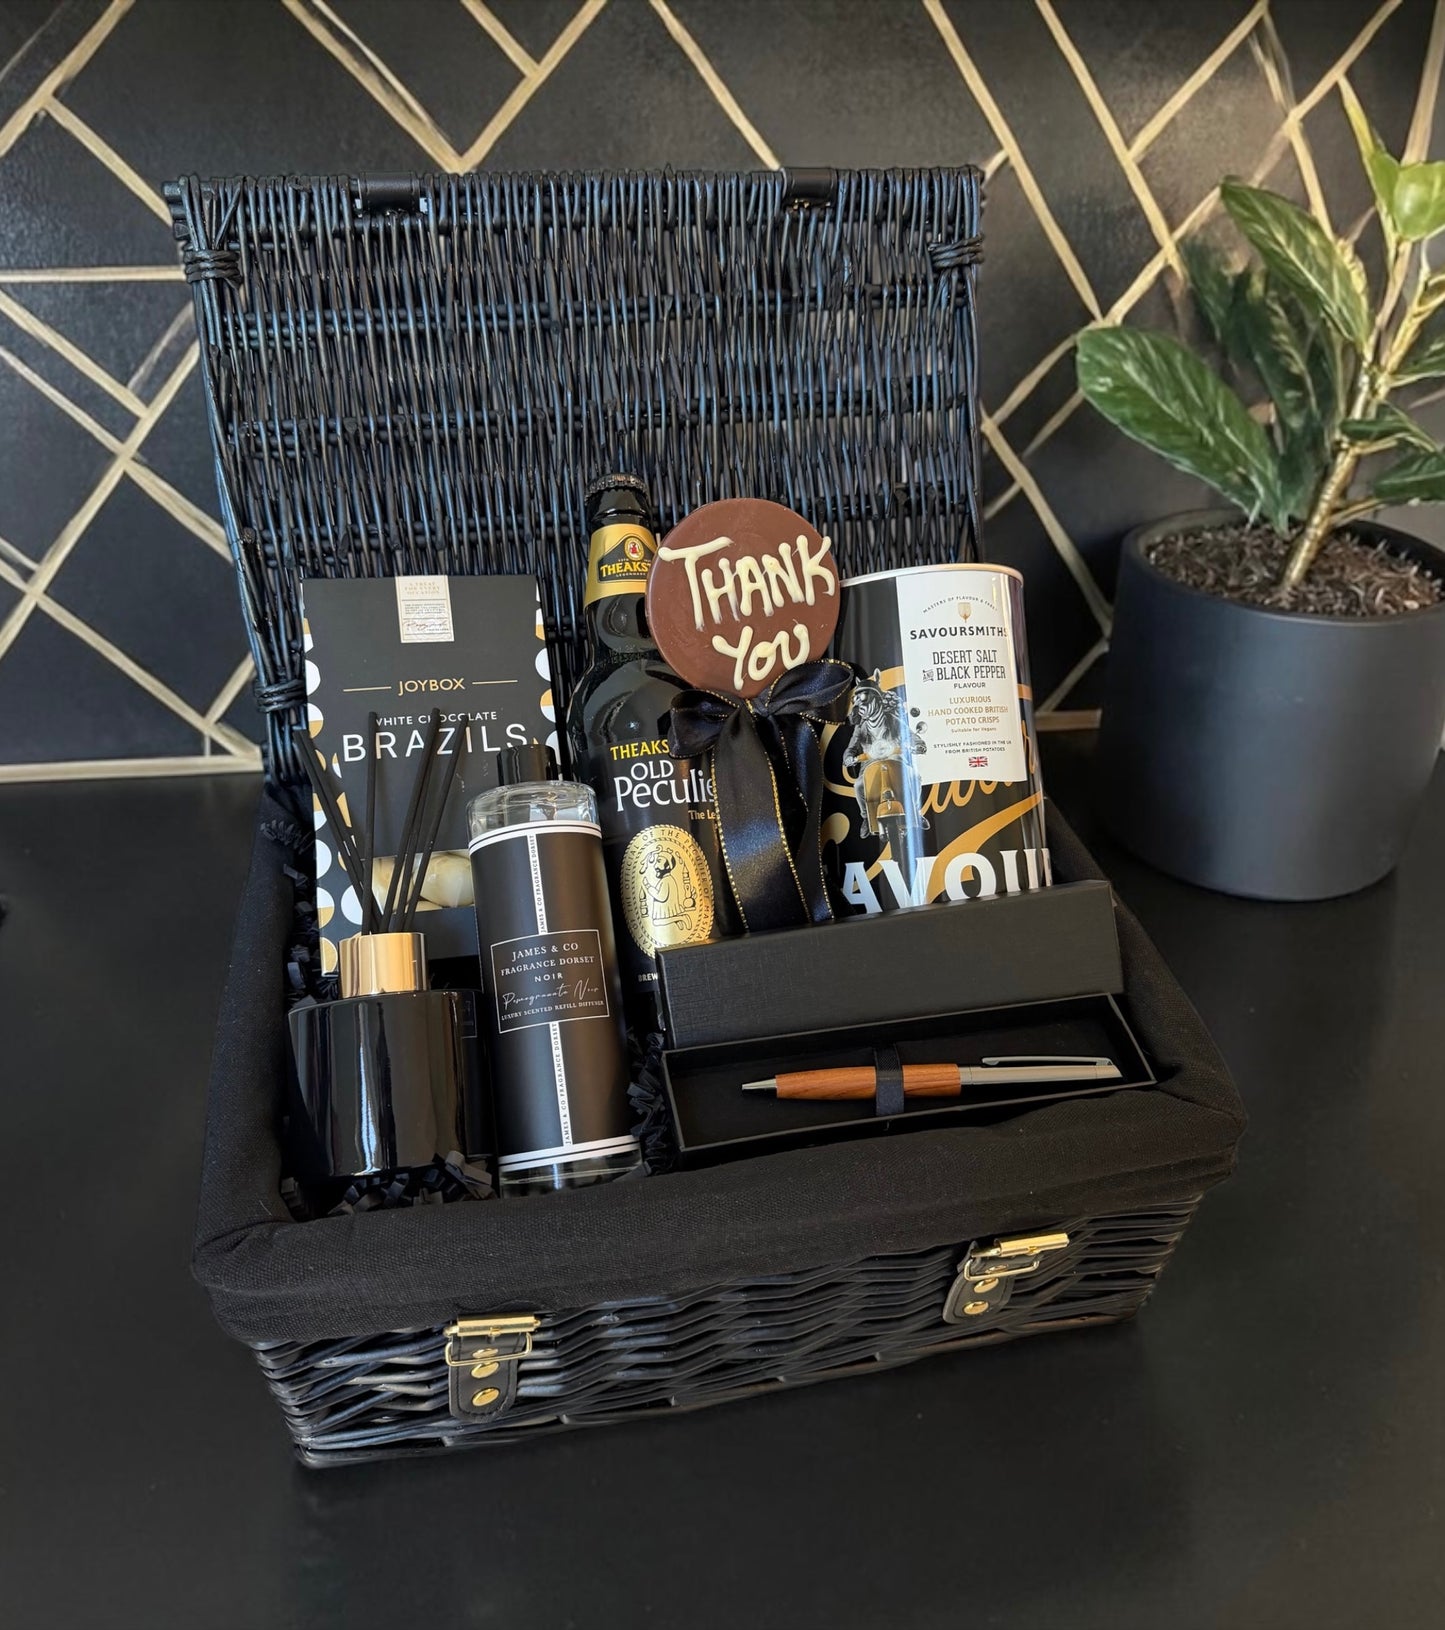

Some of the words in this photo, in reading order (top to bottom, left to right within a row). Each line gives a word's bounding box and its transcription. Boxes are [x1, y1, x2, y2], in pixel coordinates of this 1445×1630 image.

[658, 534, 835, 631] THANK
[923, 600, 946, 613] MASTERS
[932, 650, 972, 665] DESERT
[976, 649, 997, 663] SALT
[936, 665, 971, 681] BLACK
[974, 665, 1006, 679] PEPPER
[398, 677, 466, 696] JOYBOX
[949, 695, 992, 705] LUXURIOUS
[928, 708, 952, 717] HAND
[954, 707, 984, 715] COOKED
[945, 717, 976, 726] POTATO
[978, 716, 1000, 724] CRISPS
[342, 723, 528, 762] BRAZILS
[933, 741, 961, 749] STYLISHLY
[630, 759, 674, 781] OLD
[688, 810, 705, 820] The
[529, 835, 537, 858] DORSET
[624, 845, 640, 890] OFFICIAL
[642, 831, 654, 841] OF
[661, 829, 680, 838] THE
[685, 838, 708, 884] PECULIER
[532, 860, 541, 896] FRAGRANCE
[537, 897, 542, 906] CO
[539, 914, 547, 933] JAMES
[511, 945, 547, 962] JAMES
[551, 945, 559, 953] &
[562, 942, 579, 952] CO
[500, 959, 556, 977] FRAGRANCE
[559, 955, 595, 966] DORSET
[534, 972, 563, 983] NOIR
[501, 1011, 522, 1021] LUXURY
[523, 1006, 553, 1016] SCENTED
[554, 1002, 577, 1011] REFILL
[551, 1024, 560, 1051] DORSET
[555, 1054, 565, 1097] FRAGRANCE
[560, 1100, 567, 1111] CO
[563, 1121, 572, 1145] JAMES
